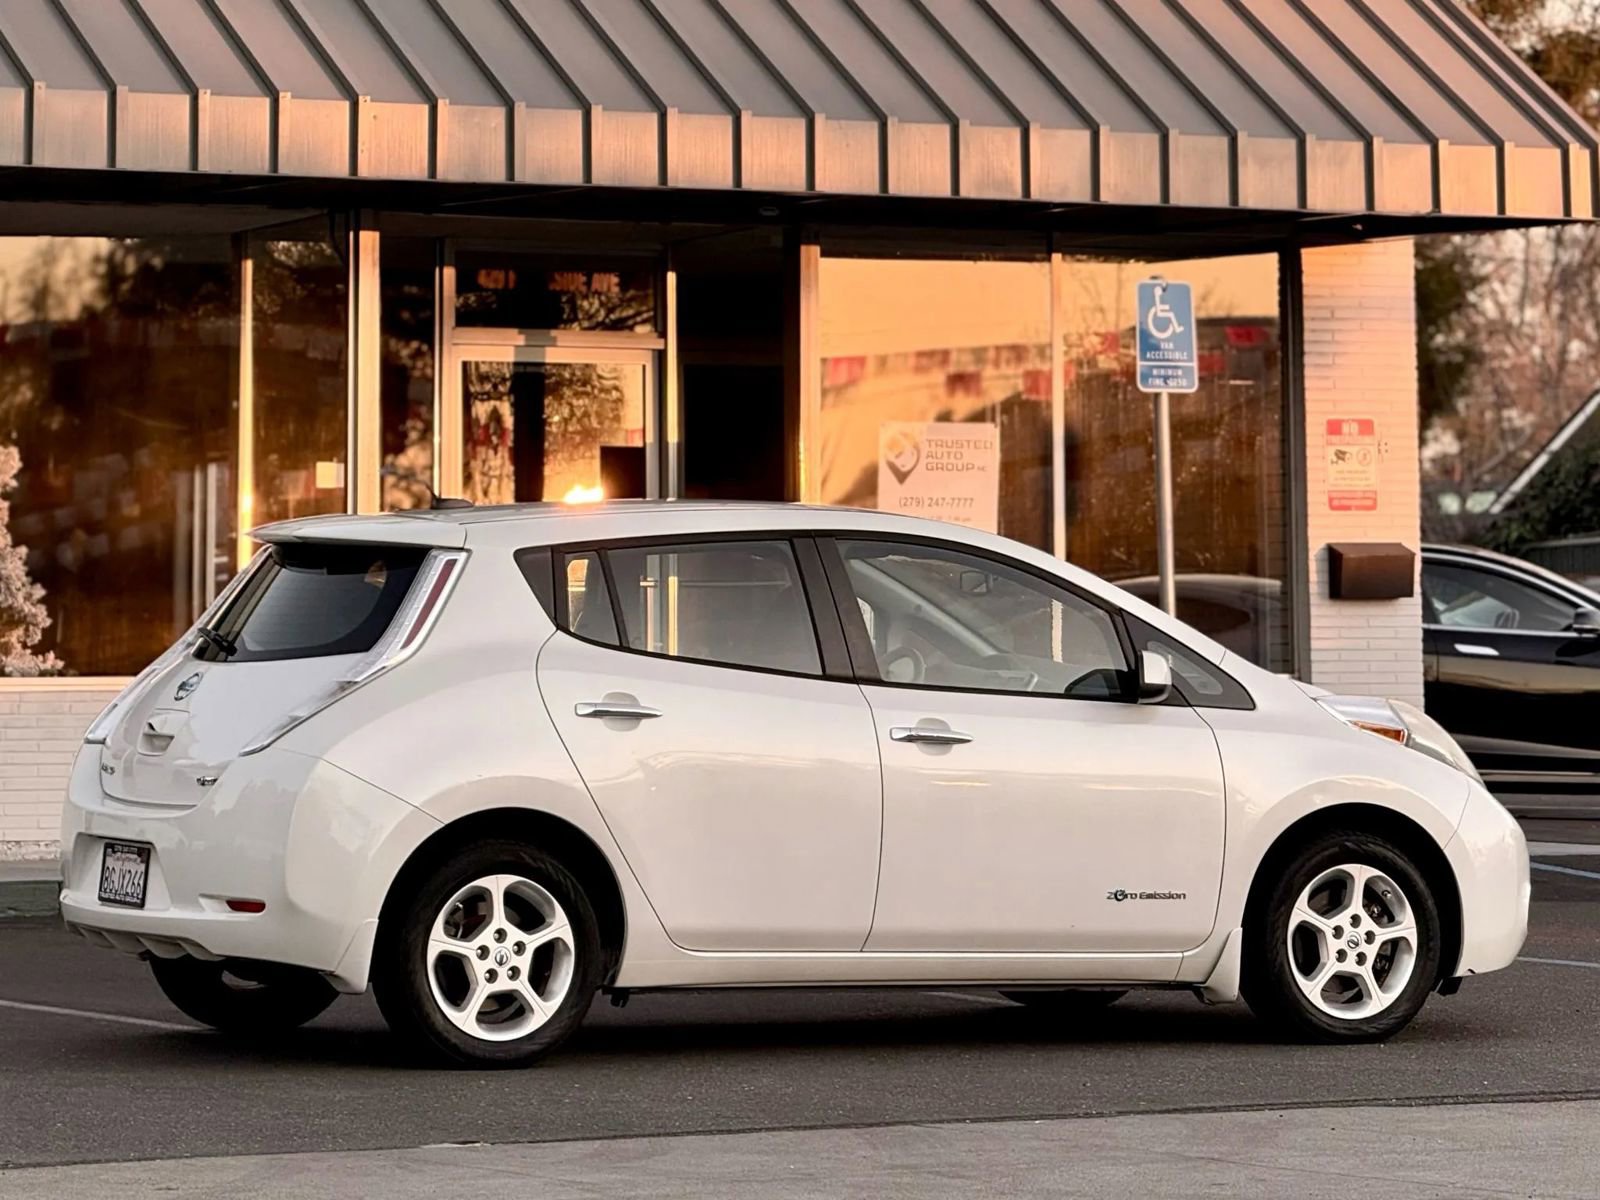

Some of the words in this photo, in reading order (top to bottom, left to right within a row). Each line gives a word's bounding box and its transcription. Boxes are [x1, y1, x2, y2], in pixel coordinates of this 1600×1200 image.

[1160, 341, 1174, 350] VAN
[1146, 351, 1188, 360] ACCESSIBLE
[1152, 368, 1183, 376] MINIMUM
[925, 438, 993, 450] TRUSTED
[925, 450, 964, 460] AUTO
[925, 461, 975, 472] GROUP
[898, 496, 925, 509] (279)
[927, 497, 974, 508] 247-7777
[103, 866, 143, 899] 8GJX266
[1139, 890, 1187, 900] Emission
